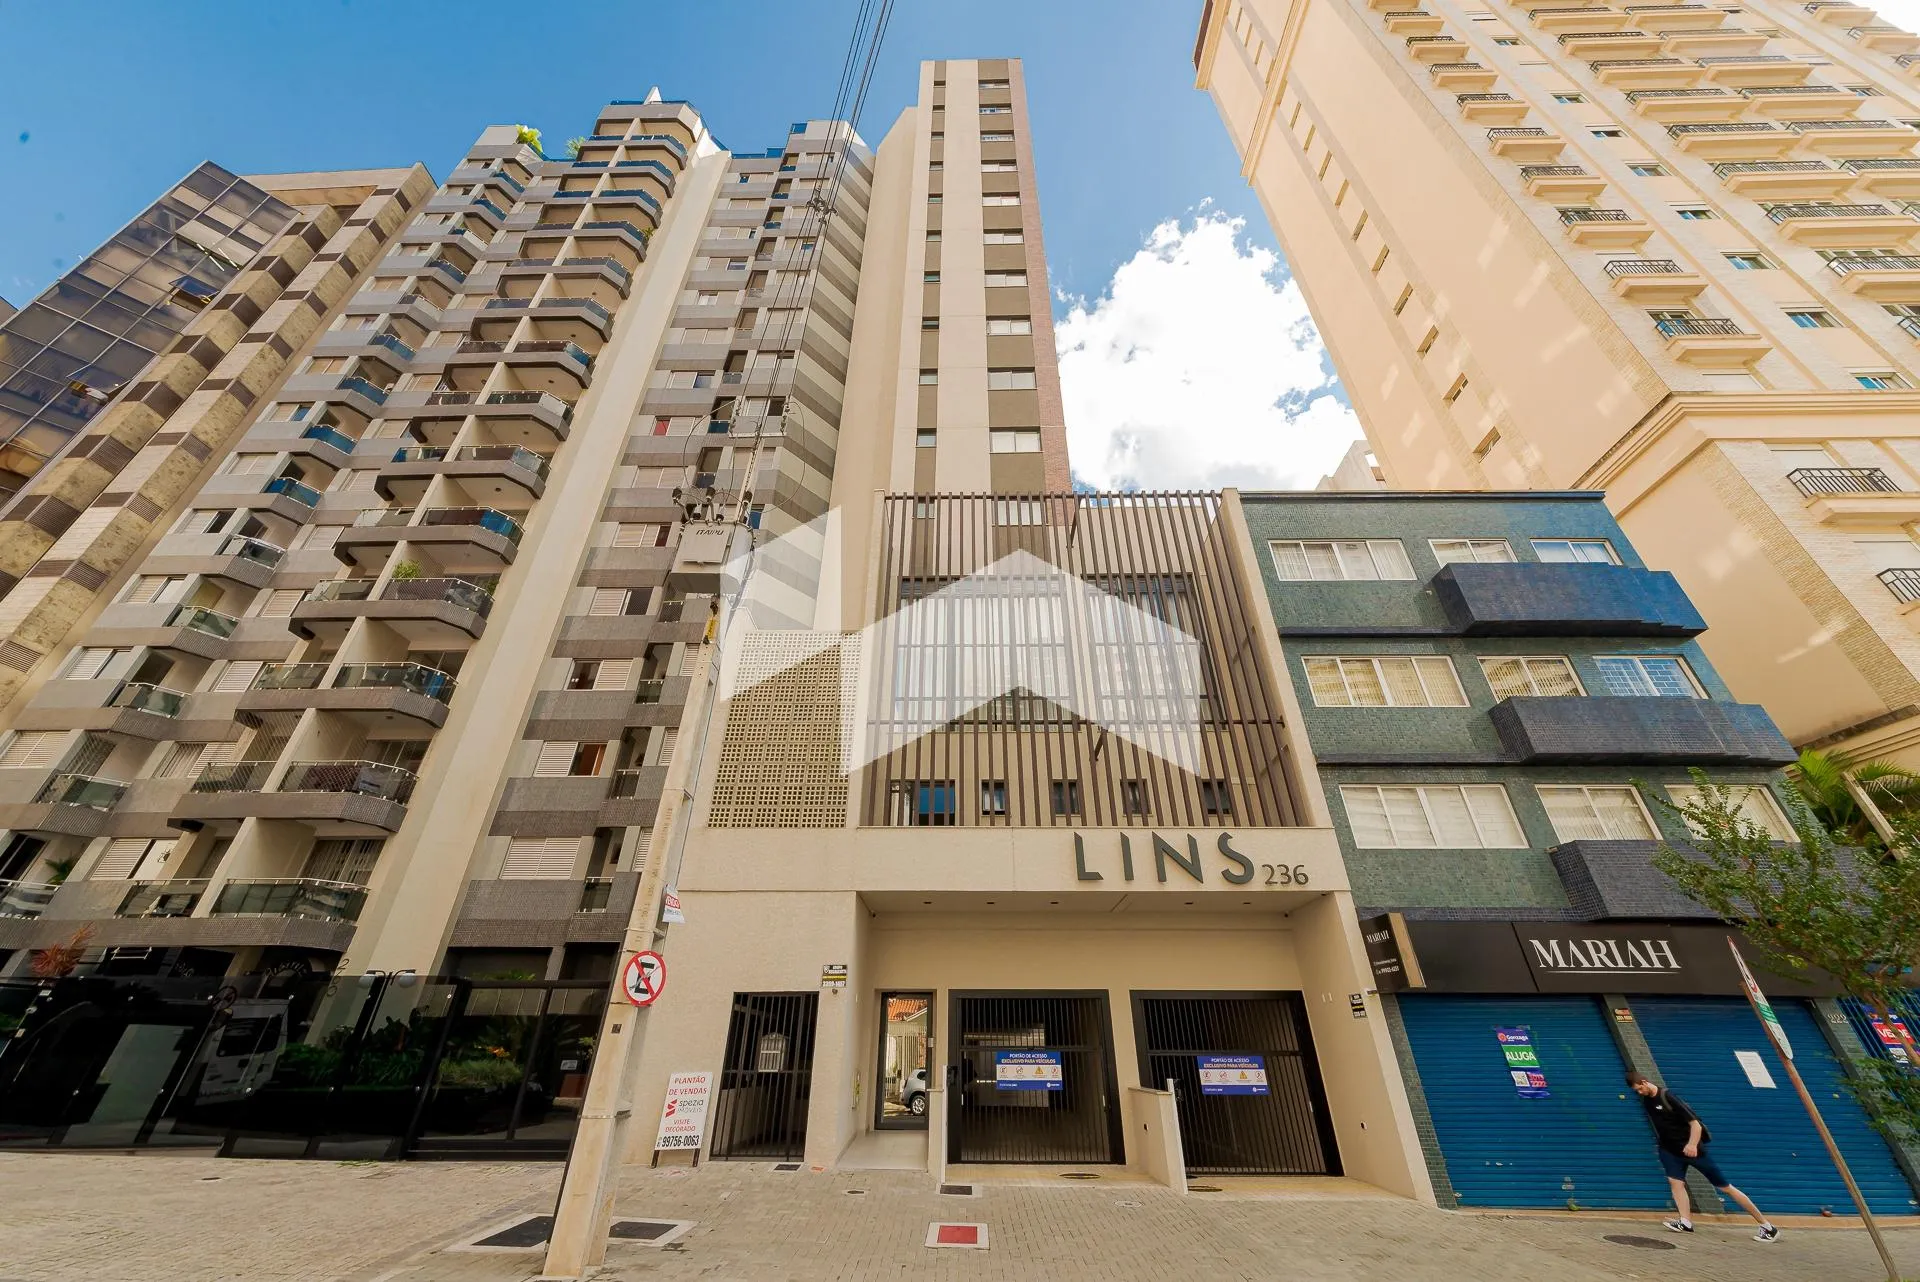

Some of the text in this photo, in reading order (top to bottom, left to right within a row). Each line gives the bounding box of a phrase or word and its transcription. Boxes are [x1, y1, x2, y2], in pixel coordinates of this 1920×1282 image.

[1073, 831, 1309, 886] LINS 236
[1528, 939, 1683, 969] MARIAH
[1876, 1028, 1911, 1039] VEE
[1505, 1051, 1537, 1061] ALUGA
[674, 1075, 706, 1084] PLANTÃO
[680, 1087, 707, 1095] VENDAS
[678, 1099, 704, 1108] spezia
[665, 1125, 696, 1133] DECORADO
[661, 1134, 700, 1148] 99756-0063
